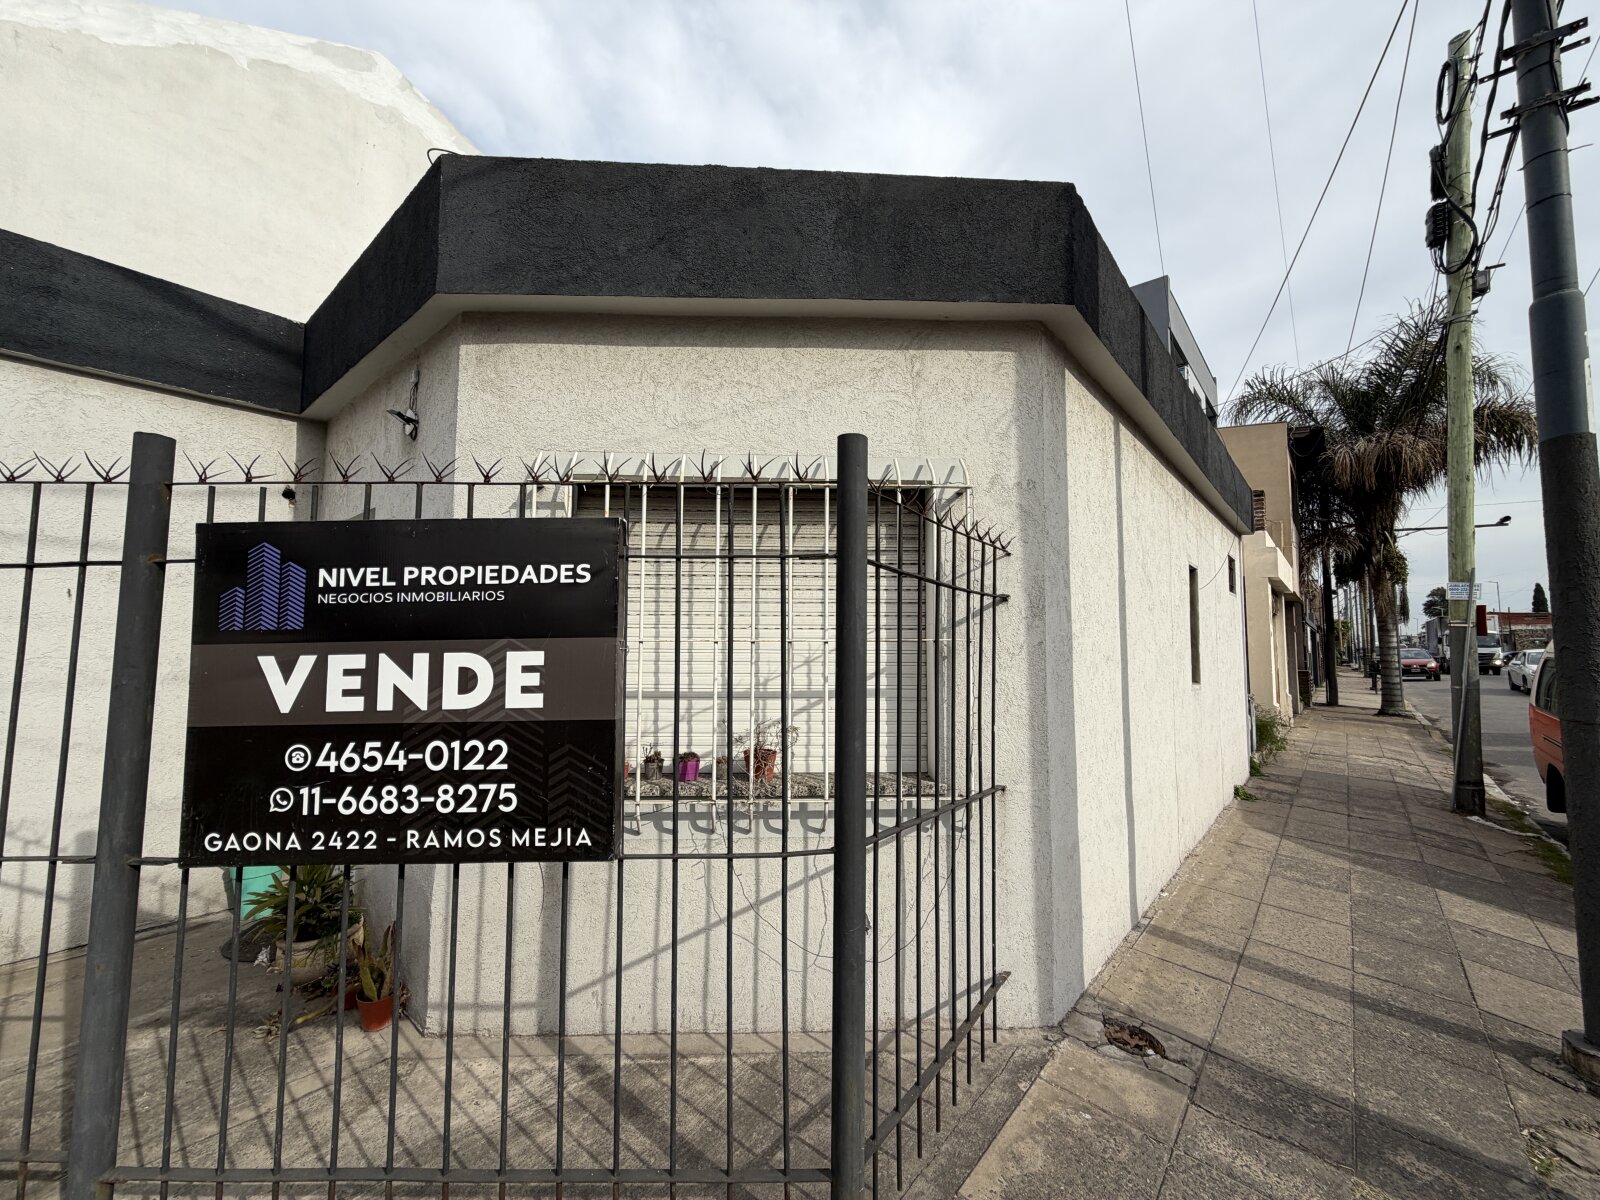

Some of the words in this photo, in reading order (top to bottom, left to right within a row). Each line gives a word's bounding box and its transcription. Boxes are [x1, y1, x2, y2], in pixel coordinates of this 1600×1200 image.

[318, 567, 396, 588] NIVEL
[403, 563, 592, 586] PROPIEDADES
[317, 592, 393, 604] NEGOCIOS
[396, 590, 505, 603] INMOBILIARIOS
[257, 650, 545, 714] VENDE
[315, 739, 509, 773] 4654-0122
[299, 783, 518, 816] 11-6683-8275
[204, 831, 302, 852] GAONA
[311, 830, 377, 851] 2422
[406, 828, 502, 849] RAMOS
[511, 827, 592, 847] MEJIA
